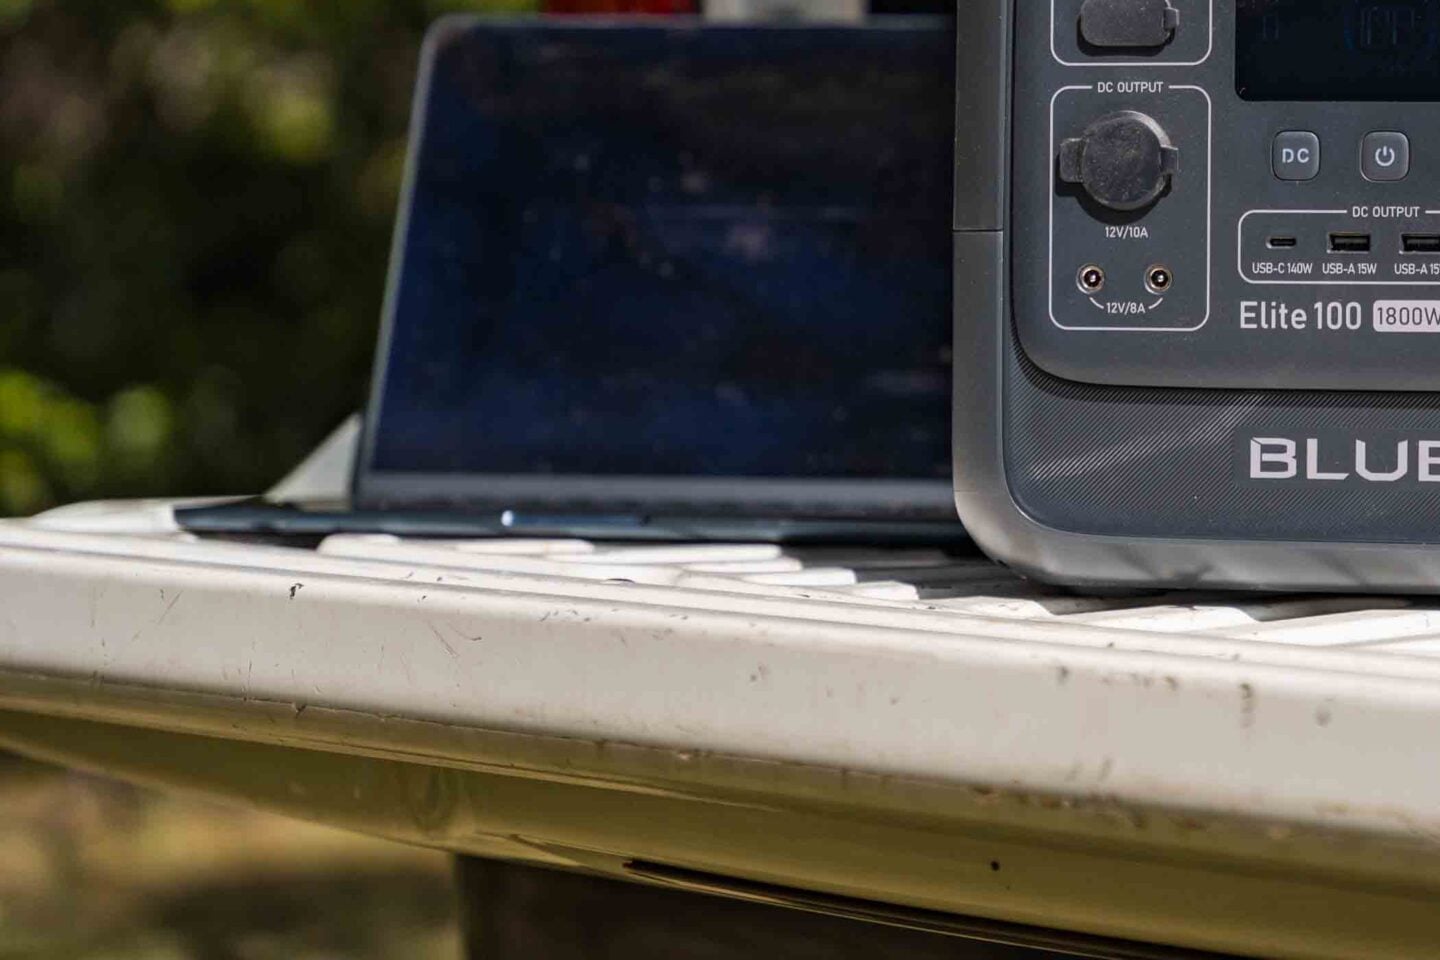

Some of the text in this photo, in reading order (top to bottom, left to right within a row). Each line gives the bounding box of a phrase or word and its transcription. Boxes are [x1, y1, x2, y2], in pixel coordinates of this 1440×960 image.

[1097, 80, 1165, 93] DC OUTPUT
[1281, 148, 1310, 164] DC
[1352, 206, 1420, 219] DC OUTPUT
[1105, 225, 1149, 240] 12V/10A
[1252, 262, 1313, 275] USB-C 140W
[1322, 262, 1377, 275] USB-A 15W
[1394, 263, 1427, 276] USB-A
[1106, 301, 1146, 316] 12V/8A
[1239, 300, 1308, 330] Elite
[1313, 300, 1362, 331] 100
